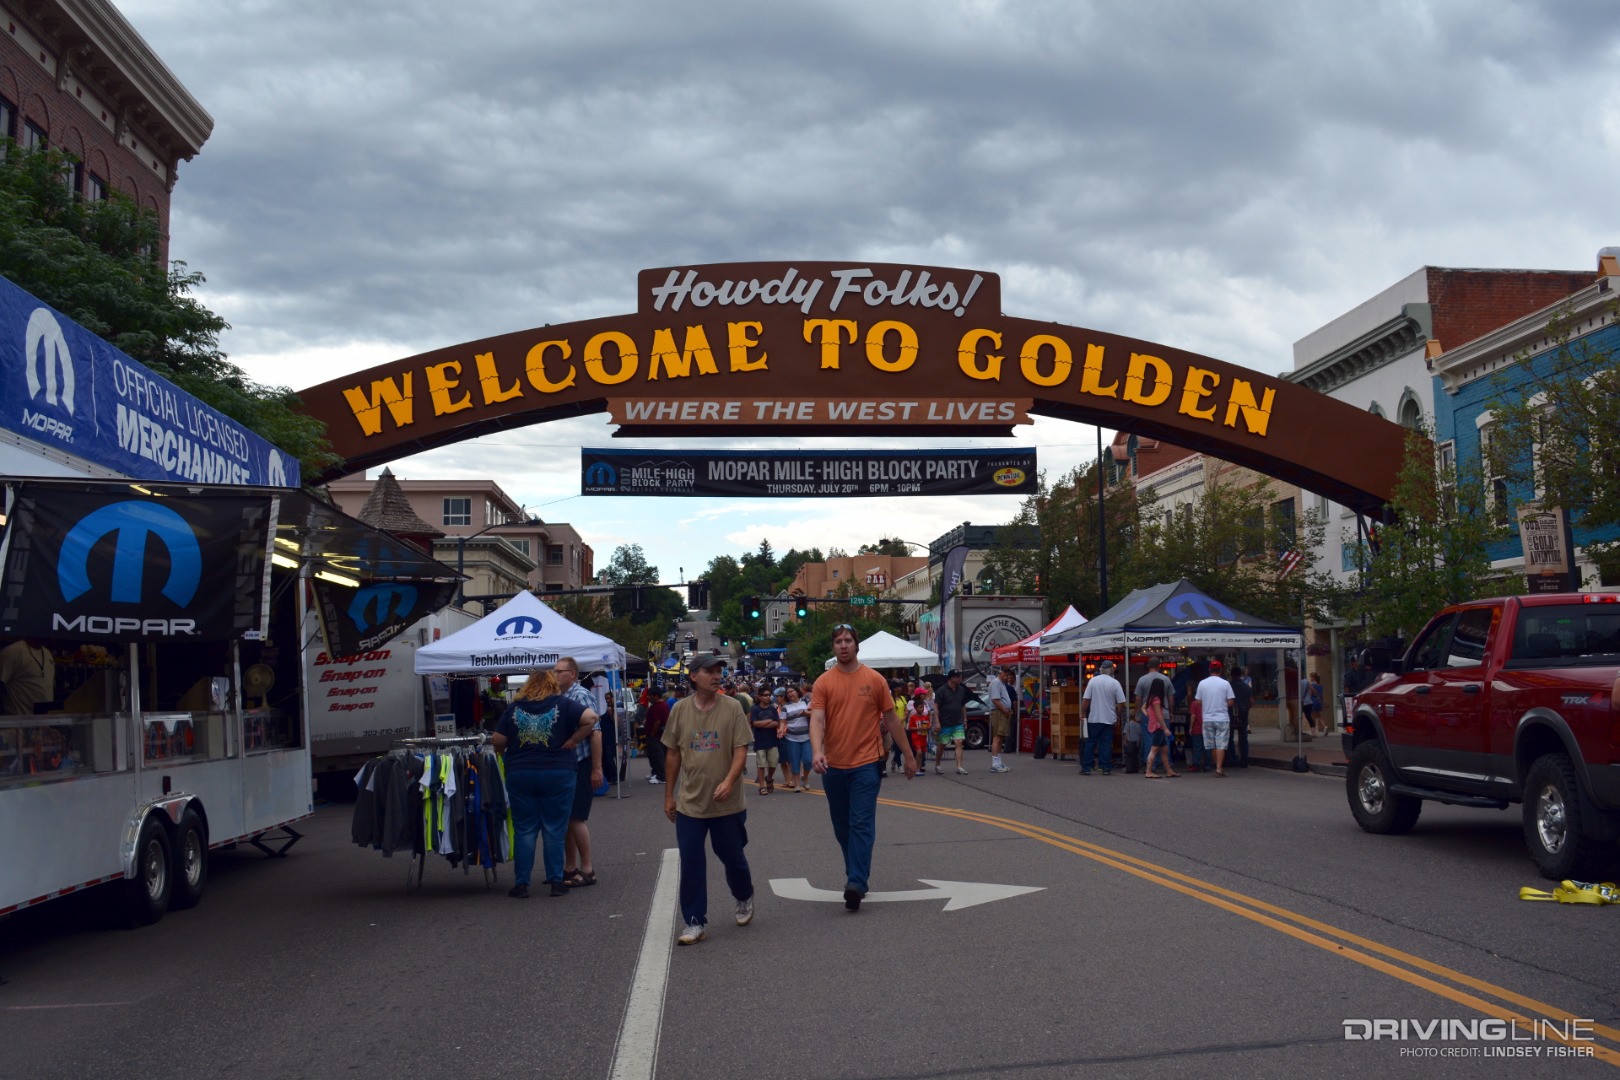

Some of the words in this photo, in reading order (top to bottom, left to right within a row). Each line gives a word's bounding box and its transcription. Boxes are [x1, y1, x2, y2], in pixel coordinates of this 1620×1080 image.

[651, 267, 824, 315] Howdy
[831, 268, 983, 318] Folks!
[342, 320, 769, 438] WELCOME
[802, 318, 920, 372] TO
[957, 328, 1277, 437] GOLDEN
[113, 359, 184, 430] OFFICIAL
[186, 395, 249, 463] LICENSED
[625, 401, 740, 420] WHERE
[752, 401, 814, 420] THE
[826, 401, 917, 420] WEST
[930, 401, 1015, 420] LIVES
[22, 408, 73, 443] MOPAR
[117, 405, 250, 485] MERCHANDISE
[631, 468, 695, 479] MILE-HIGH
[708, 461, 770, 480] MOPAR
[774, 460, 863, 480] MILE-HIGH
[868, 460, 923, 480] BLOCK
[925, 459, 979, 479] PARTY
[620, 467, 631, 491] 2017
[631, 479, 661, 487] BLOCK
[666, 479, 695, 488] PARTY
[766, 484, 817, 495] THURSDAY,
[818, 483, 839, 493] JULY
[869, 483, 889, 493] 6PM
[897, 483, 920, 493] 10PM
[1533, 535, 1554, 551] GOLD
[850, 597, 865, 605] 12th
[52, 612, 196, 635] MOPAR
[1175, 618, 1242, 626] MOPAR
[973, 635, 985, 651] BORN
[985, 622, 994, 632] IN
[1010, 622, 1028, 640] ROCK
[470, 652, 560, 667] TechAuthority.com
[319, 668, 386, 682] Snap-on
[326, 686, 378, 697] Snap-on
[328, 701, 375, 712] Snap-on
[437, 724, 453, 734] SALE
